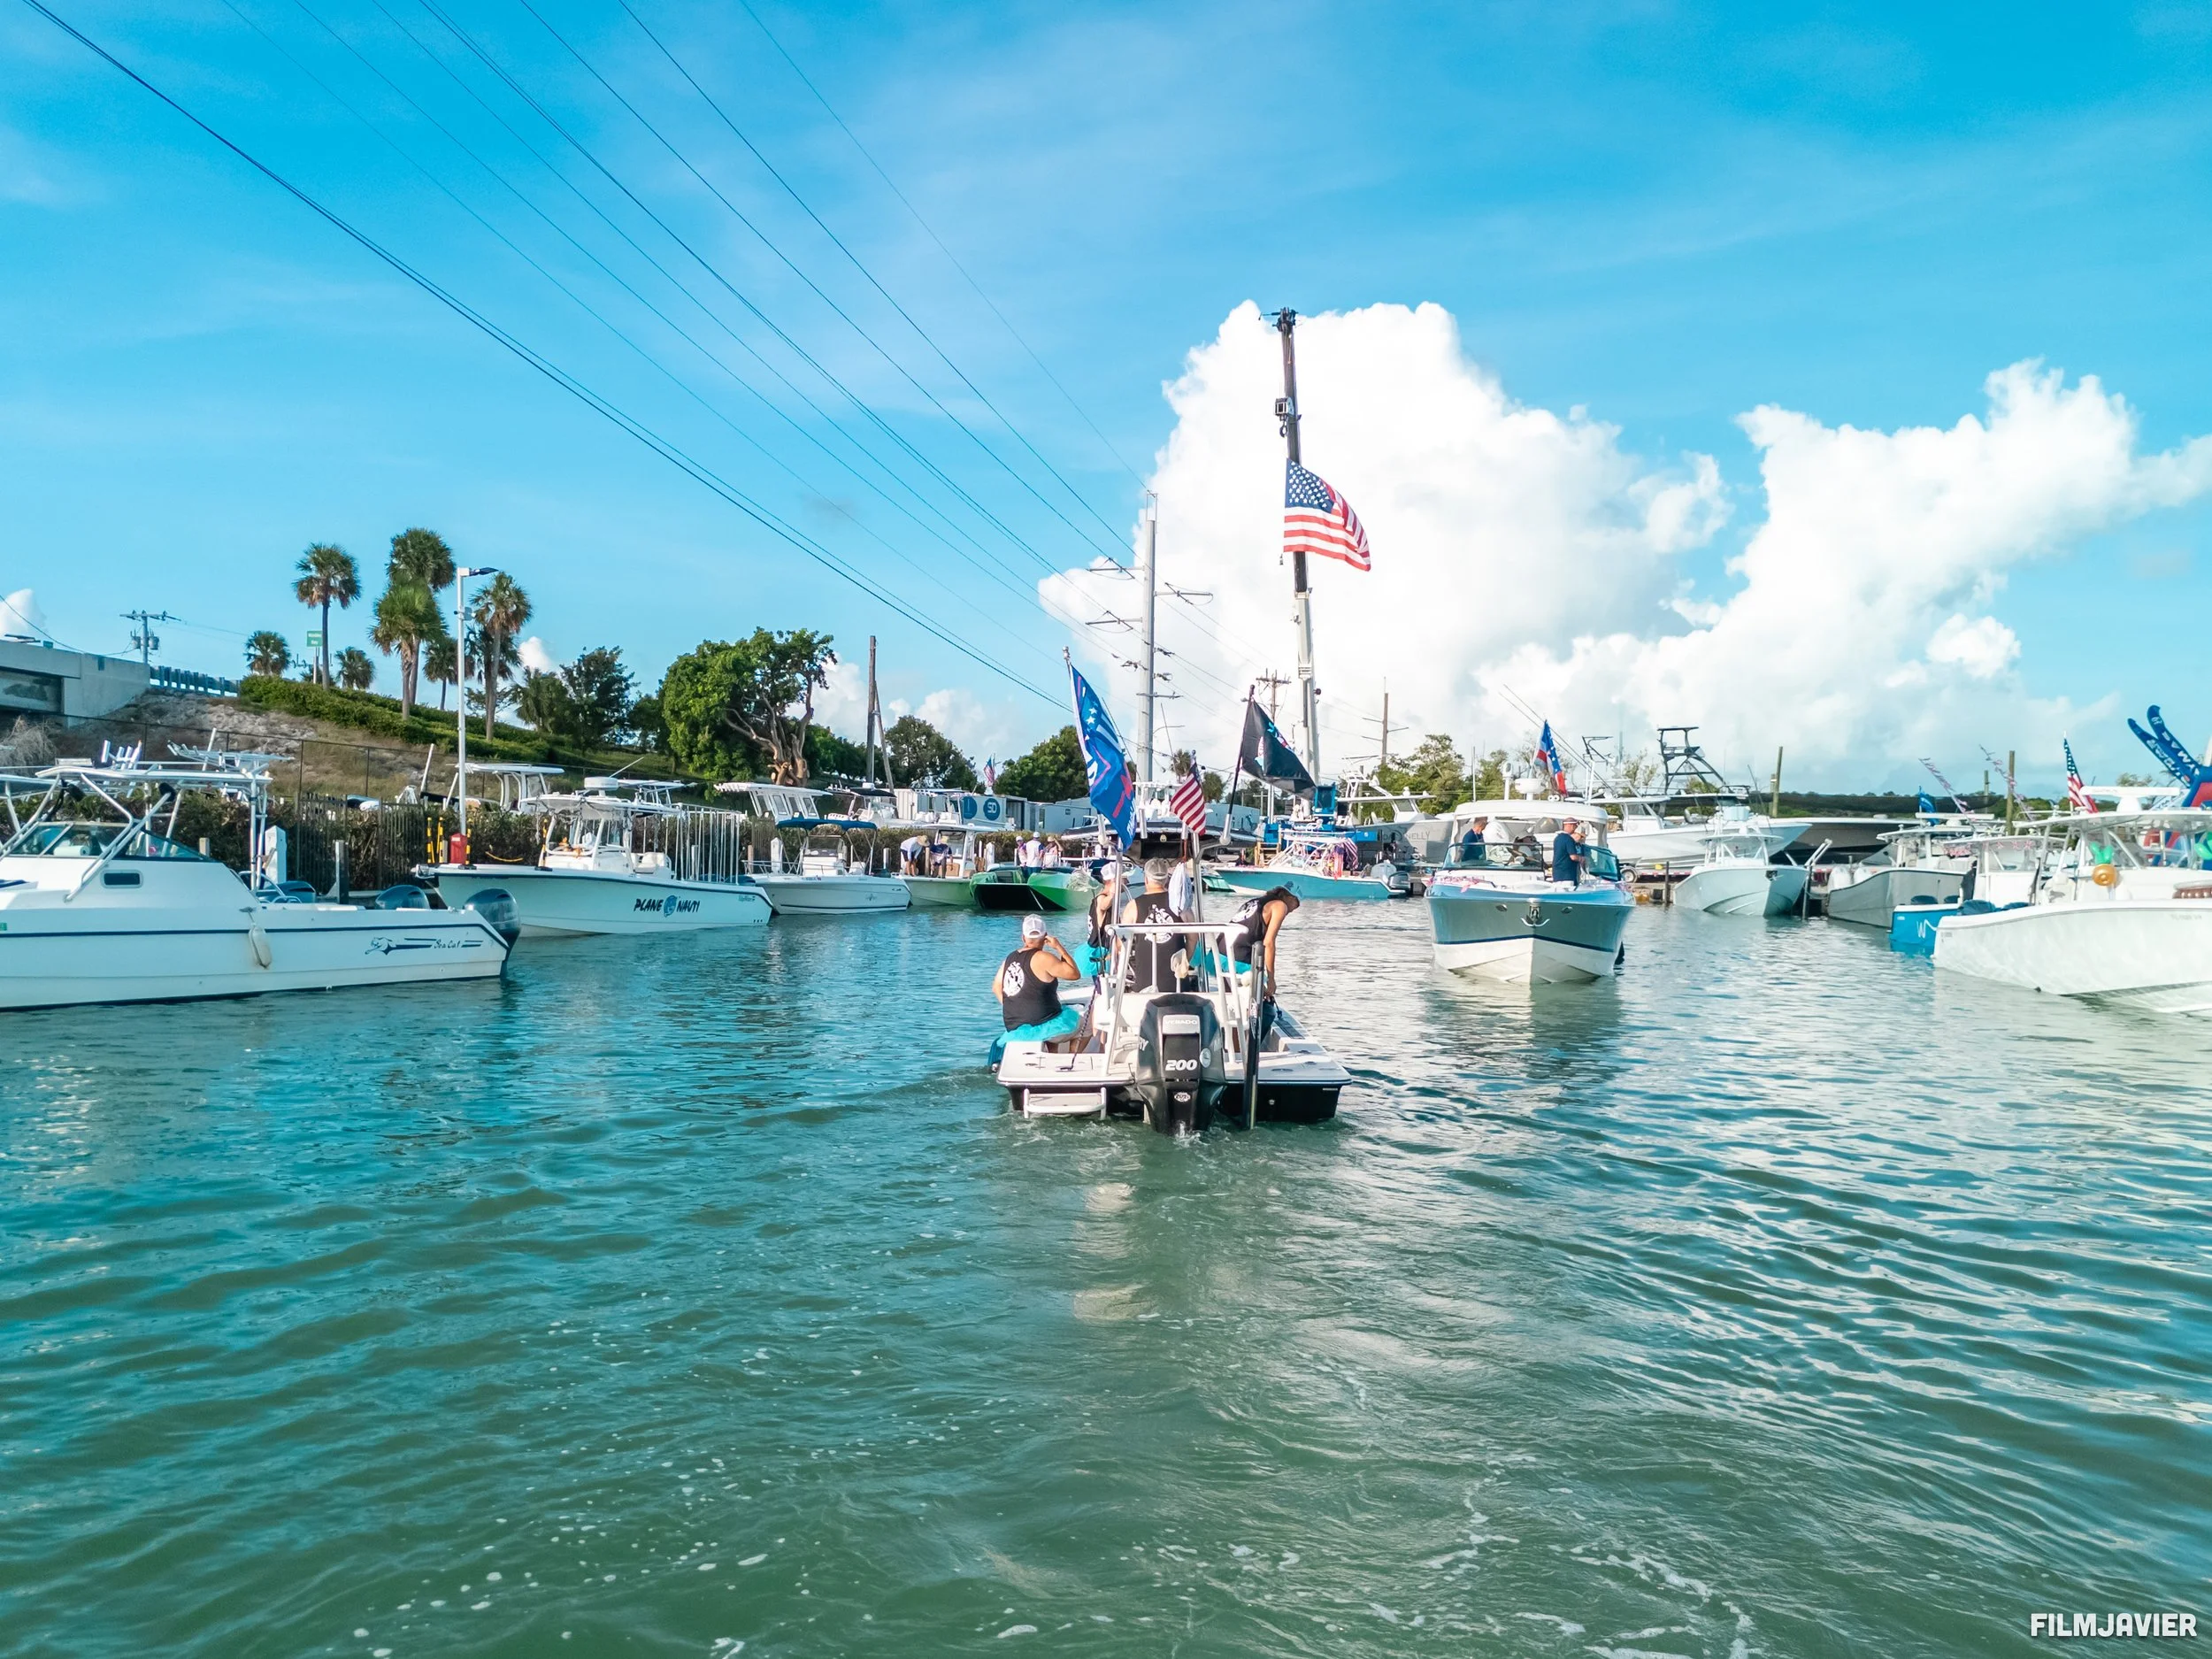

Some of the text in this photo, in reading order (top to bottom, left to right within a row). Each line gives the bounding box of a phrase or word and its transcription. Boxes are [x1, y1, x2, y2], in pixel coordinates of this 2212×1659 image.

[634, 898, 701, 912] PLANE NAUTI
[434, 939, 446, 949] Sea
[1164, 1059, 1197, 1071] 200
